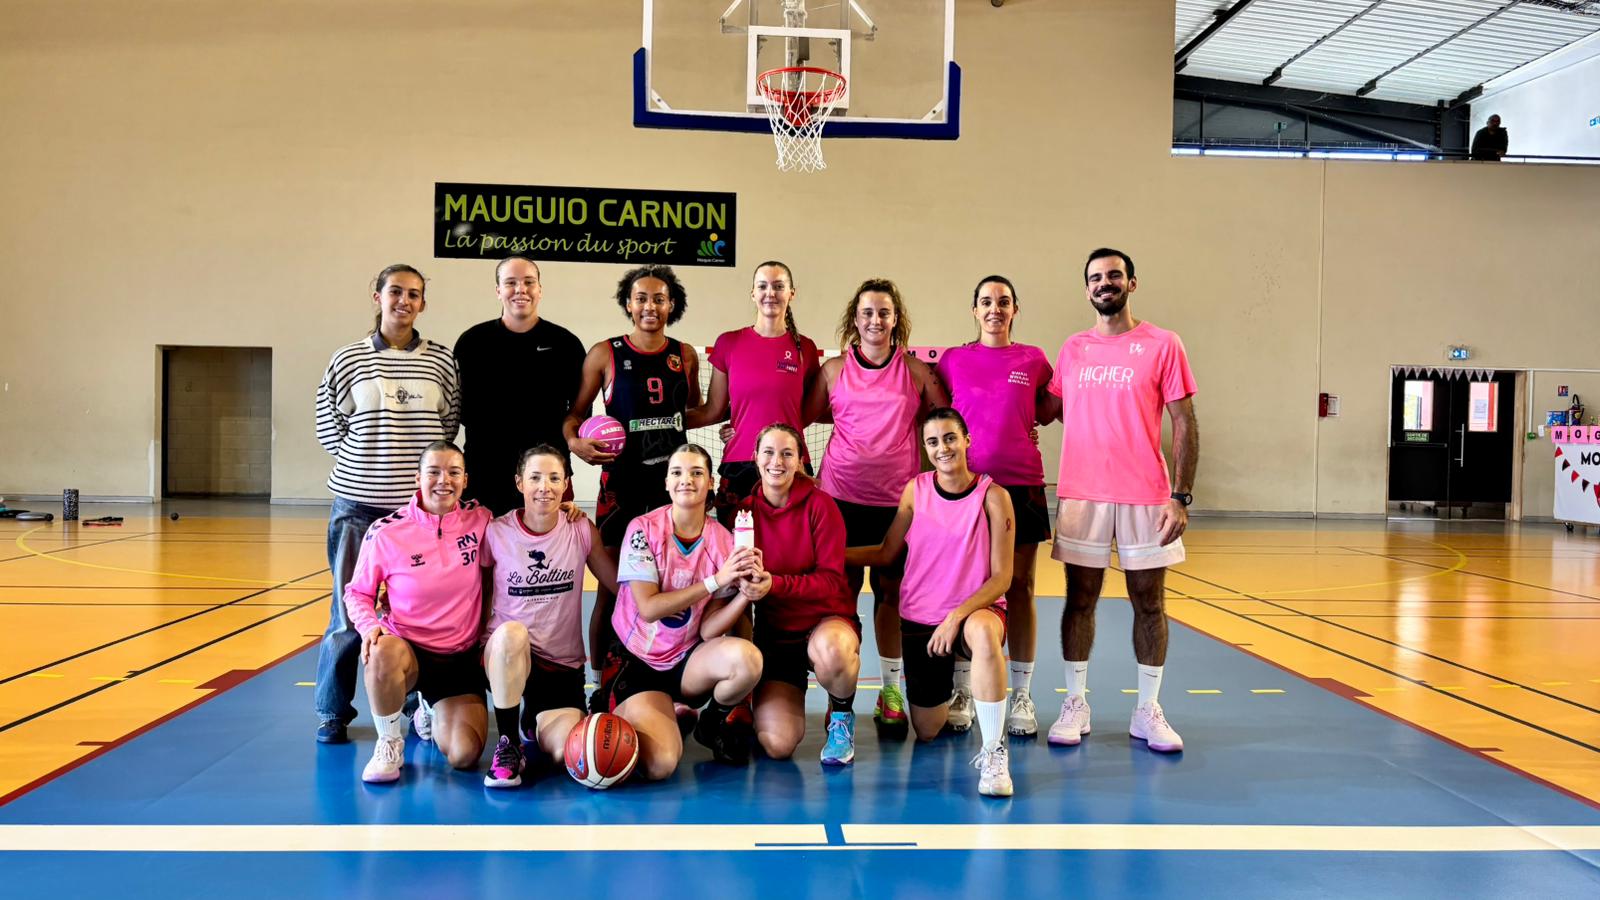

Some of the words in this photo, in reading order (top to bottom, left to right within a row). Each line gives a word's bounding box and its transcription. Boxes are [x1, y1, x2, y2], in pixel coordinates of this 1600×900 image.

[444, 193, 587, 225] MAUGUIO
[599, 199, 726, 230] CARNON
[444, 229, 478, 248] La
[480, 233, 574, 255] passion
[577, 233, 613, 252] du
[617, 238, 677, 259] sport
[1080, 366, 1134, 384] HIGHER
[647, 378, 663, 404] 9
[640, 417, 677, 426] HECTARE
[456, 532, 478, 548] RN
[461, 549, 477, 566] 30
[507, 571, 523, 585] La
[526, 569, 575, 585] Bottine
